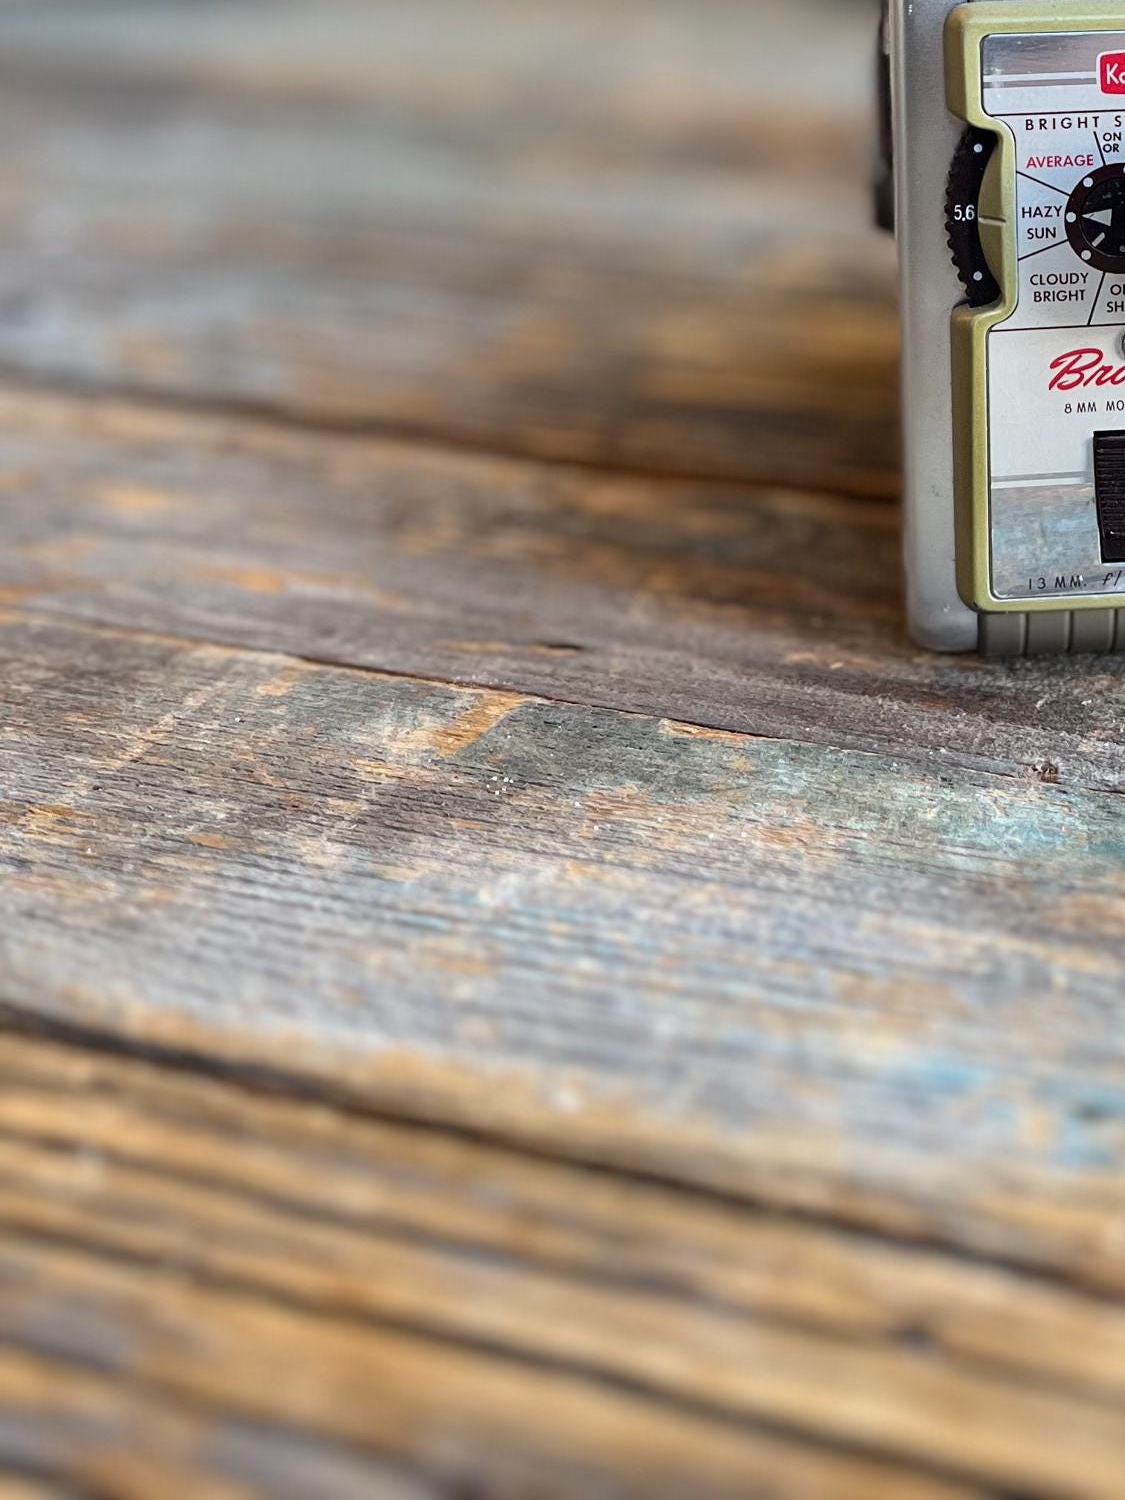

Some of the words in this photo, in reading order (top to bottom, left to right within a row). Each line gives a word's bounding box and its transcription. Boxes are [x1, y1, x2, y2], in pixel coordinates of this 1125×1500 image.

[1025, 115, 1100, 131] BRIGHT
[1102, 131, 1122, 142] ON
[1102, 143, 1120, 153] OR
[1026, 154, 1094, 168] AVERAGE
[953, 204, 975, 222] 5.6
[1021, 205, 1063, 219] HAZY
[1026, 227, 1057, 240] SUN
[1029, 272, 1089, 286] CLOUDY
[1033, 289, 1086, 303] BRIGHT
[1064, 403, 1073, 414] 8
[1077, 401, 1097, 413] MM
[1028, 577, 1046, 590] 13
